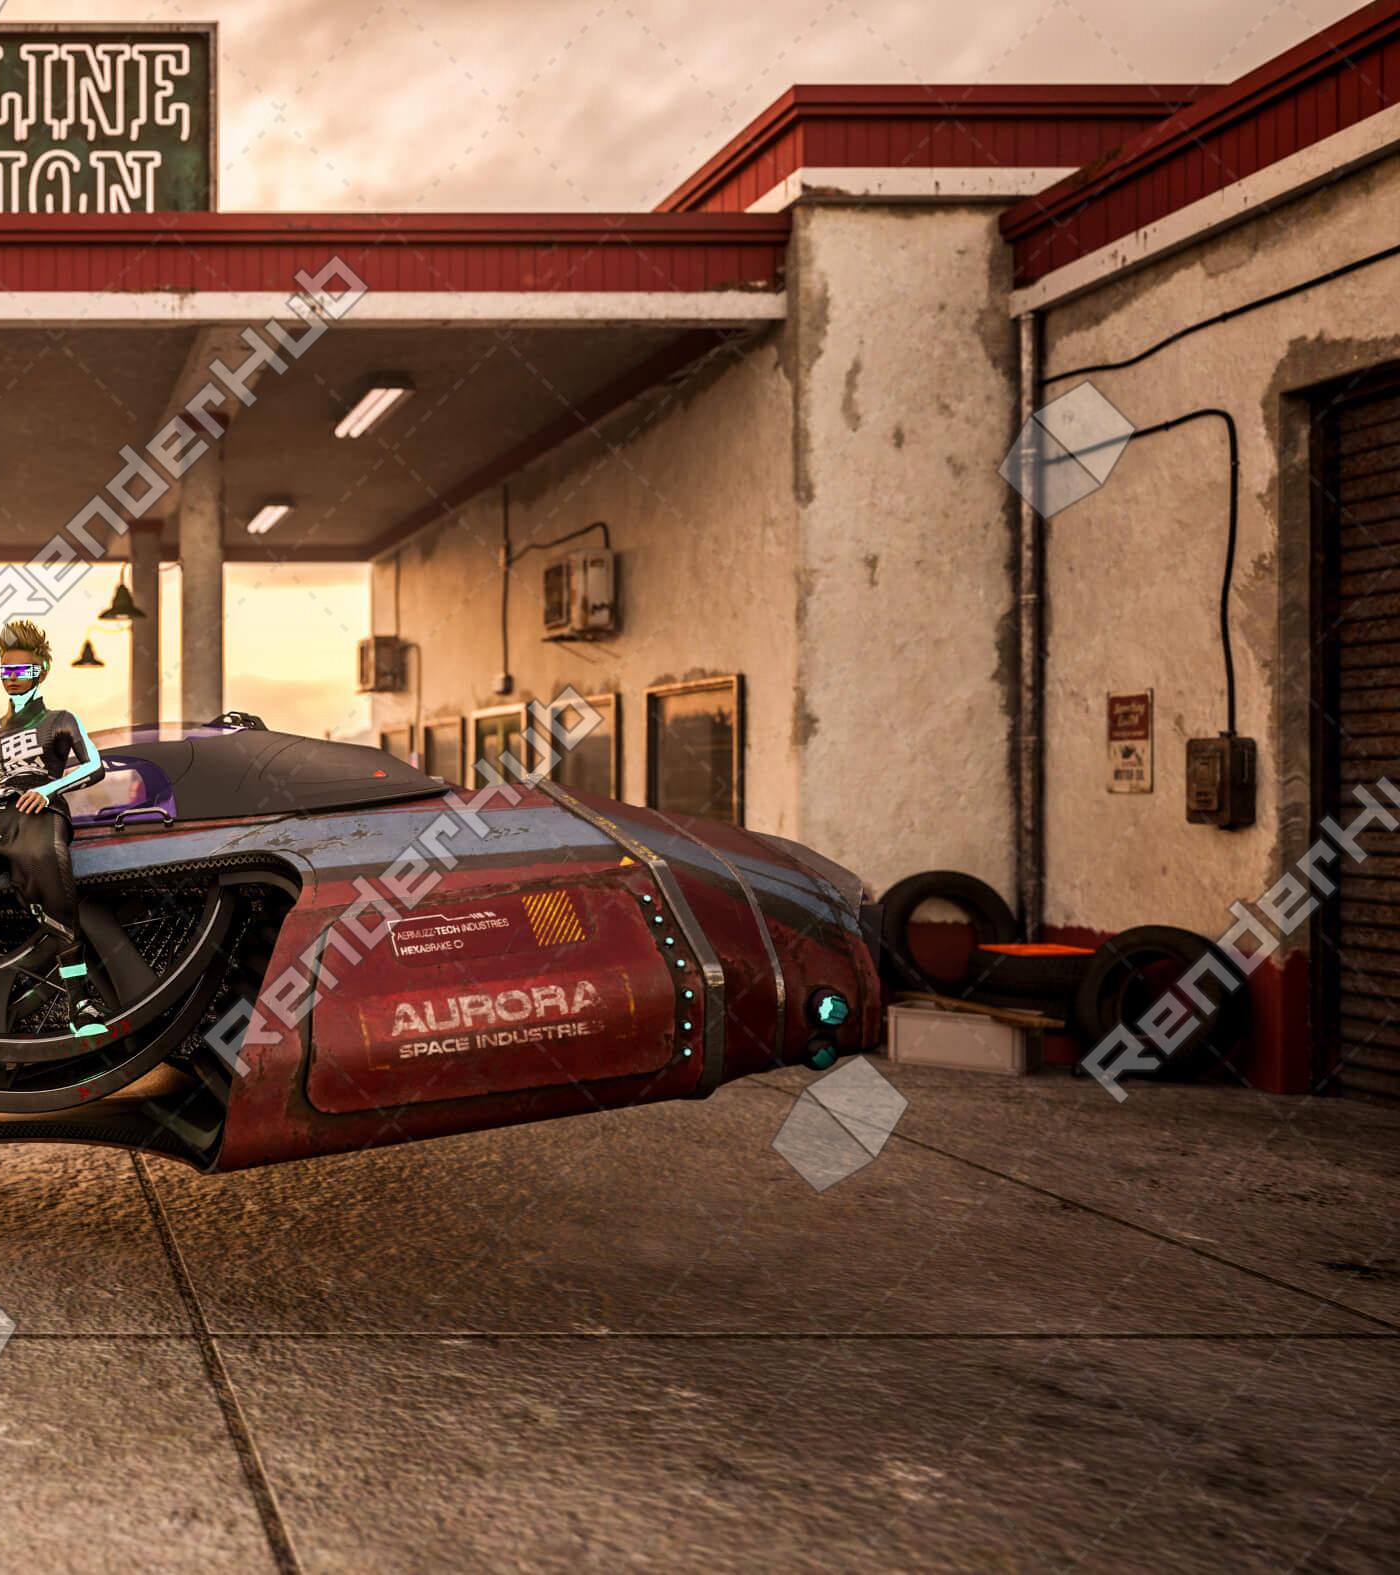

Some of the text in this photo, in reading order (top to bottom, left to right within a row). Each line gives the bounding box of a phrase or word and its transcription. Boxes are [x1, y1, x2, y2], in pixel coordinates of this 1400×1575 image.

[461, 918, 510, 933] INDUSTRIES
[400, 941, 453, 956] HEXABRAKE
[392, 980, 607, 1036] AURORA
[400, 1036, 470, 1059] SPACE
